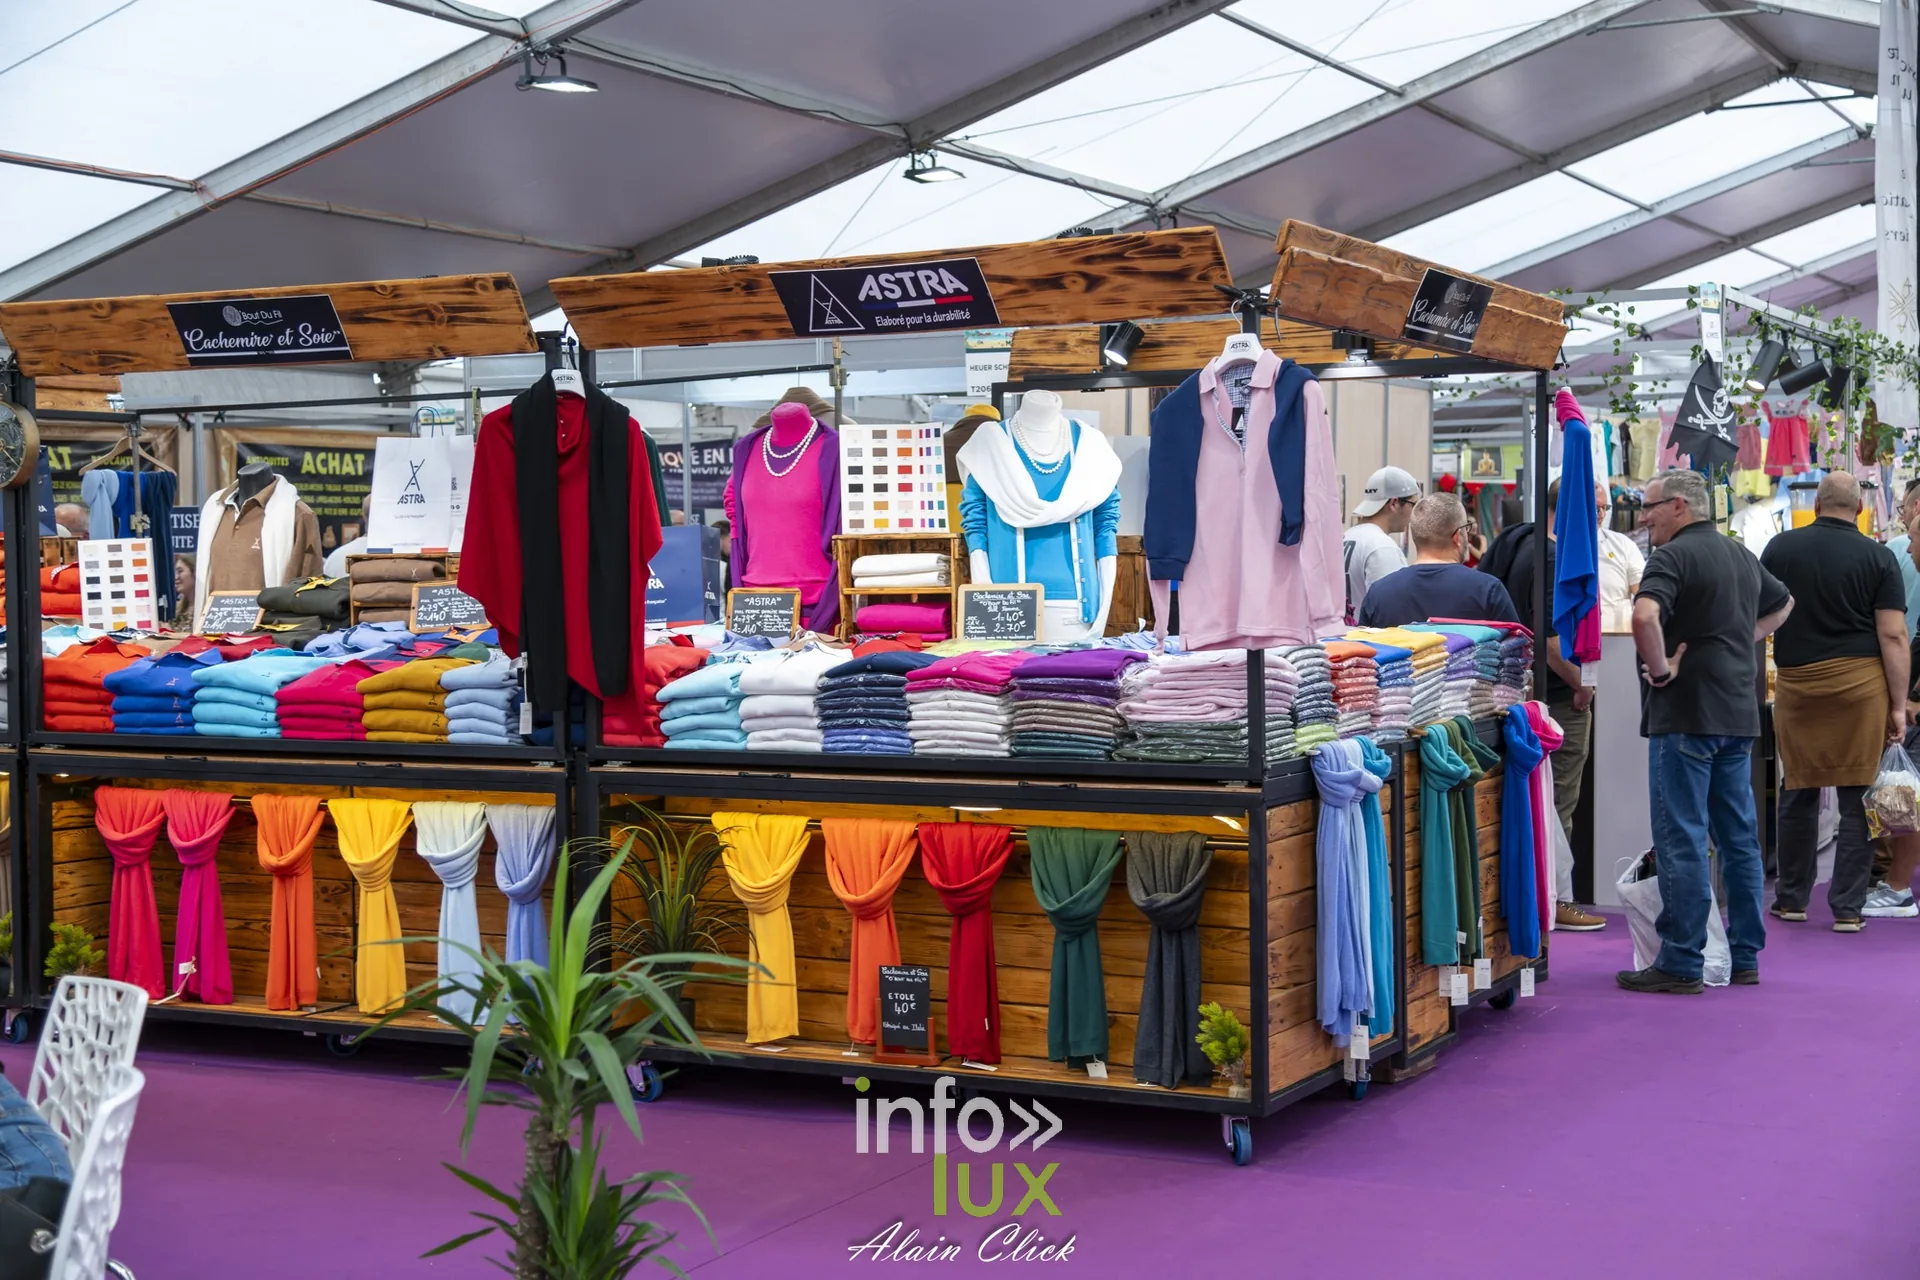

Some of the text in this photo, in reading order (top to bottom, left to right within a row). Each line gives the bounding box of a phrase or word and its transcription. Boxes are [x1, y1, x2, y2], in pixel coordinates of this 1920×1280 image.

[858, 268, 969, 301] ASTRA
[261, 310, 273, 319] Du
[274, 310, 282, 318] Fil
[875, 308, 971, 328] Elaboré pour la durabilité
[278, 328, 294, 346] et
[1230, 341, 1249, 349] ASTRA
[301, 451, 365, 476] ACHAT
[703, 447, 725, 464] EN
[397, 493, 426, 505] ASTRA
